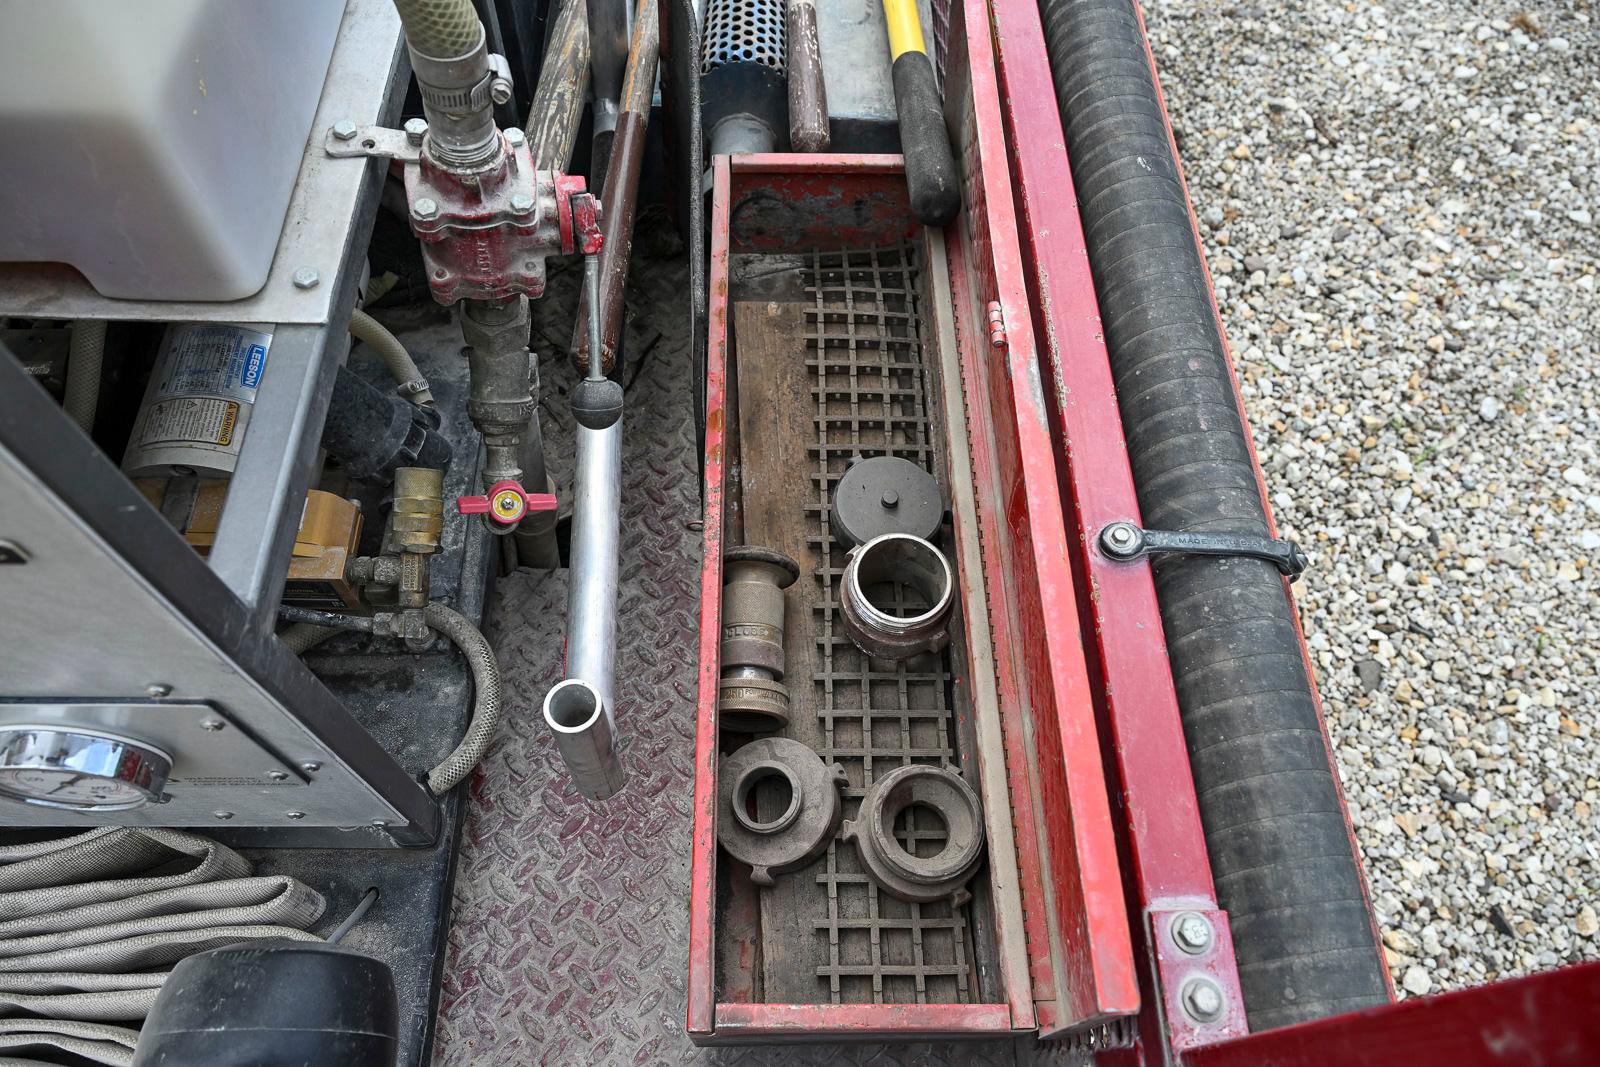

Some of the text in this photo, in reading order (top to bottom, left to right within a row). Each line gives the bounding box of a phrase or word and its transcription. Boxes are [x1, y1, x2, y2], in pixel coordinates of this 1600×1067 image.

[245, 346, 263, 386] LEESON
[220, 411, 235, 442] WARNING
[1178, 537, 1208, 545] MADE
